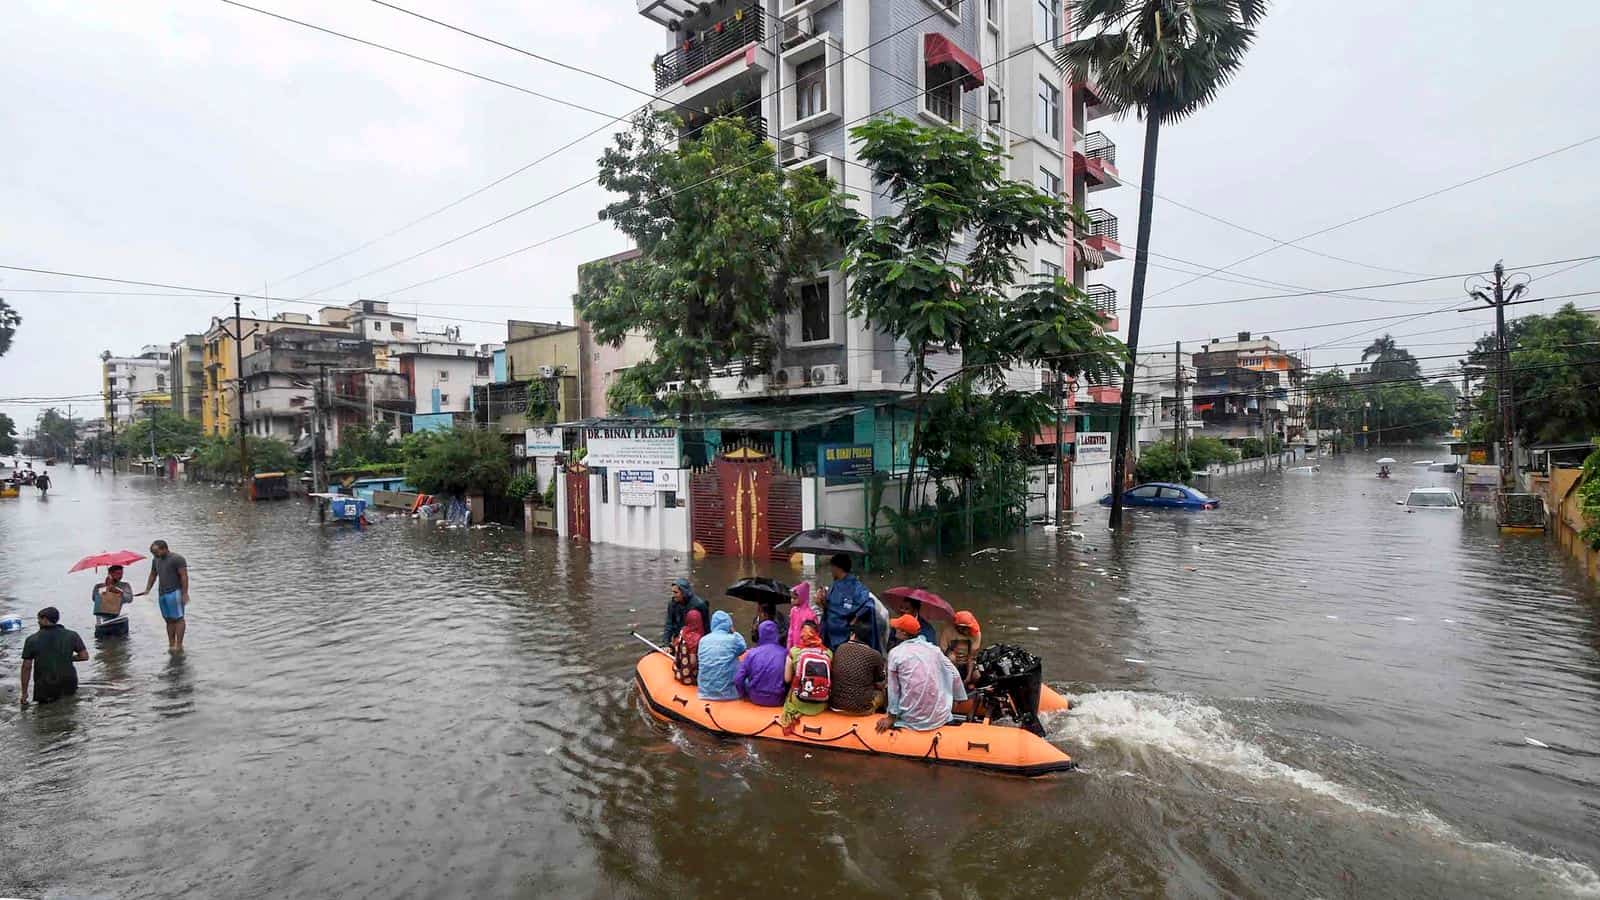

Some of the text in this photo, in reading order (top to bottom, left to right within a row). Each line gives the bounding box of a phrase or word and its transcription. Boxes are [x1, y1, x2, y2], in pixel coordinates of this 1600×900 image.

[588, 428, 675, 439] DR. BINAY PRASAD
